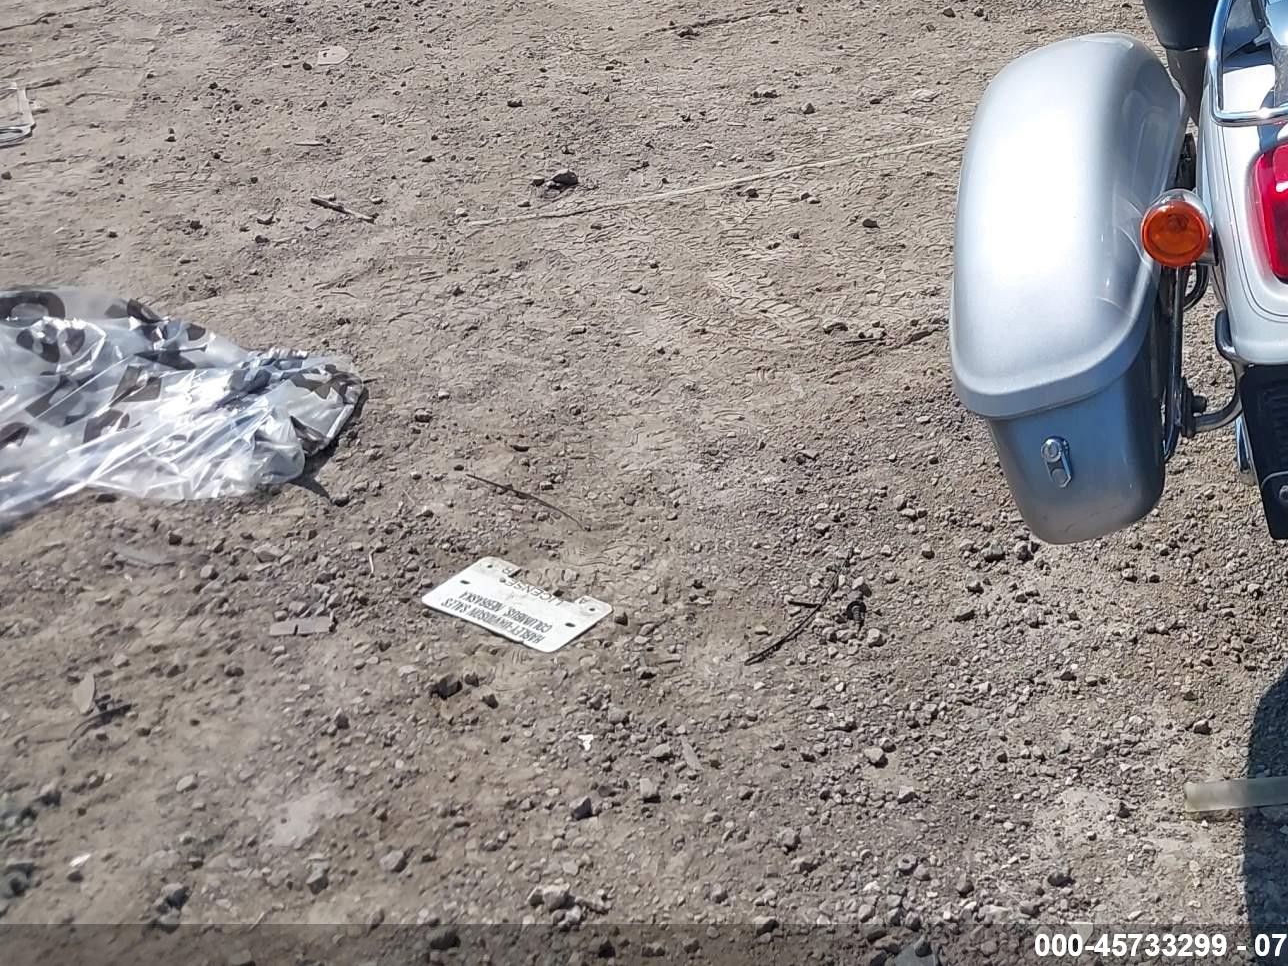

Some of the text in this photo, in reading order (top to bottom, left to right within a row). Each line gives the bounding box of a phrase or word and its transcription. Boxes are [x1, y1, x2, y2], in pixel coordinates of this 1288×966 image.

[458, 591, 505, 612] NEBRASKA
[440, 597, 546, 644] HARLEY-DAVIDSON SALES
